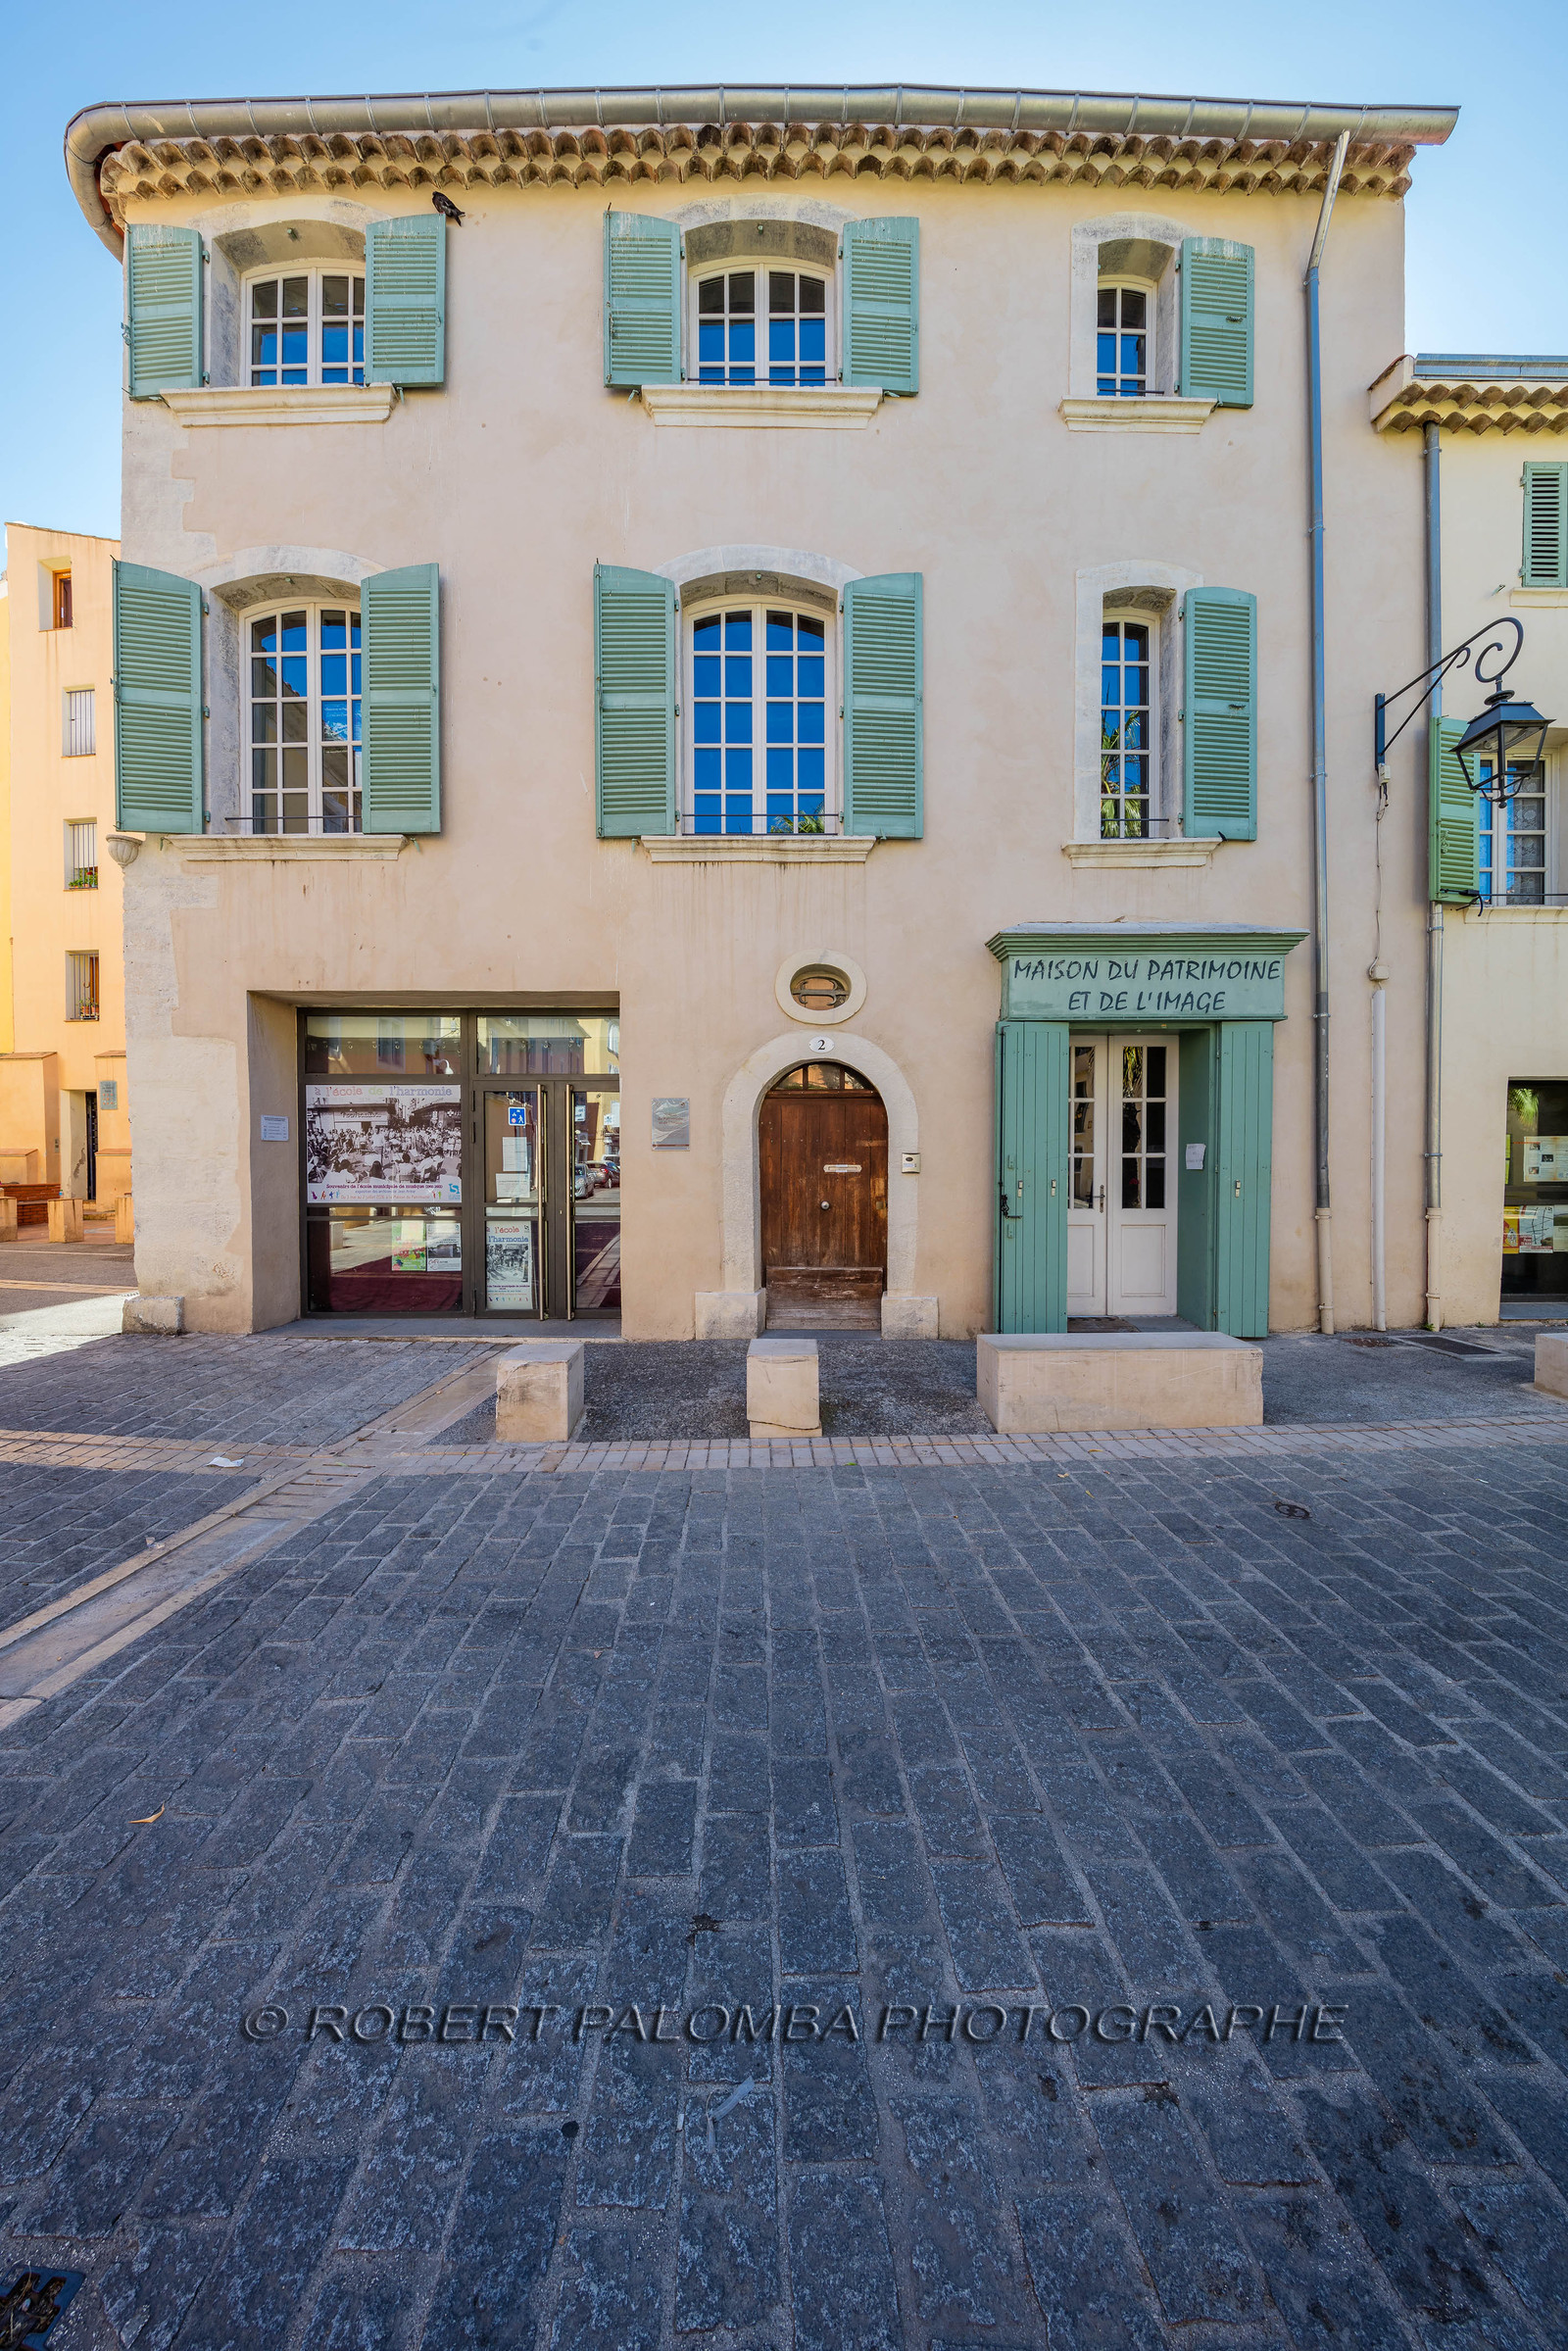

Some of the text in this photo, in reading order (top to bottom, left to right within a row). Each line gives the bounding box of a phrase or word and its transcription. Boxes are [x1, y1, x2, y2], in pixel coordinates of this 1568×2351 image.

[1014, 959, 1281, 980] MAISON DU PATRIMOINE
[1068, 991, 1226, 1013] ET DE L'IMAGE
[817, 1039, 826, 1051] 2
[325, 1086, 363, 1097] l'école
[368, 1086, 383, 1096] de
[389, 1085, 453, 1097] l'harmonie
